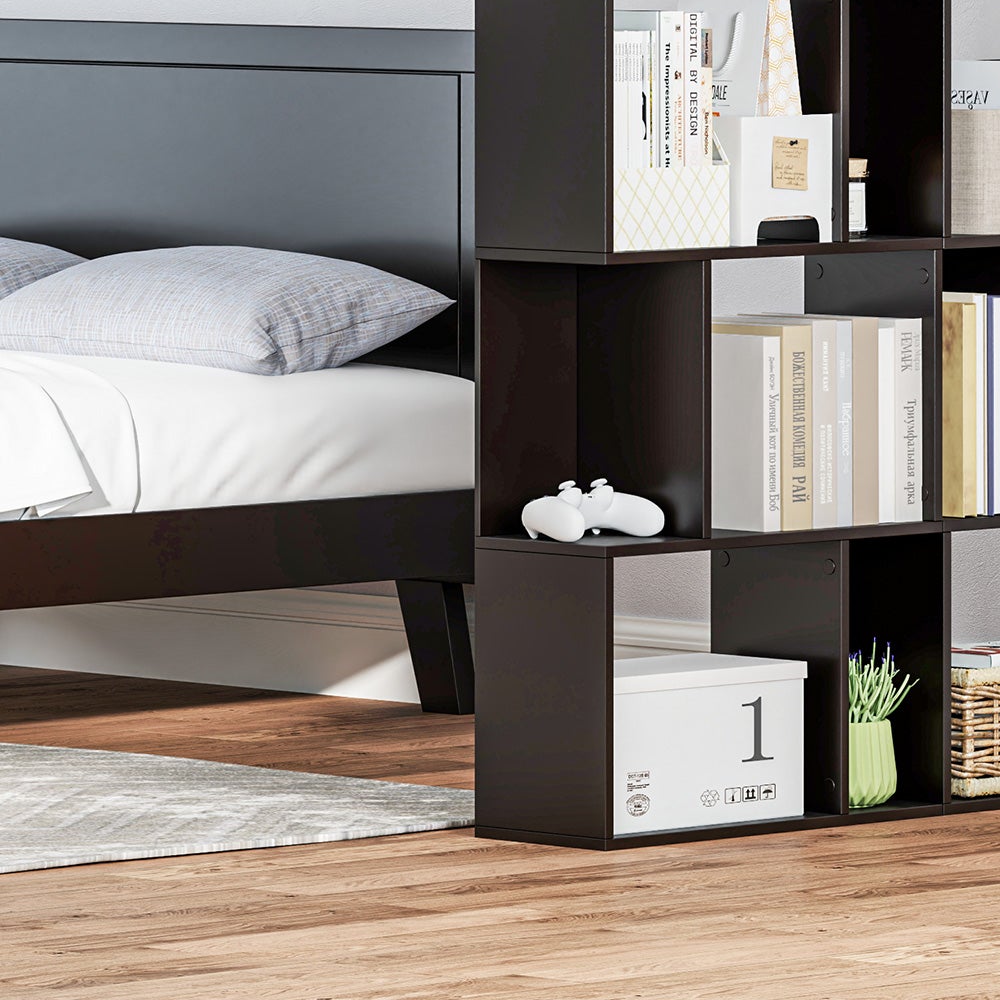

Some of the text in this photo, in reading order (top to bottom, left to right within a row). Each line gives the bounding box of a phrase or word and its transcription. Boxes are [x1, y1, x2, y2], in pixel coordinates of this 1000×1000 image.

[689, 13, 698, 136] DIGITAL BY DESIGN
[663, 64, 671, 142] Impressionists
[664, 144, 671, 155] at
[768, 393, 780, 433] Уличный
[792, 351, 810, 503] БОЖЕСТВЕННАЯ КОМЕДИЯ РАЙ
[768, 435, 777, 449] кот
[768, 452, 777, 462] по
[903, 398, 917, 505] Триумфальная арка
[768, 462, 777, 493] имени
[768, 494, 780, 512] Боб
[742, 696, 774, 762] 1
